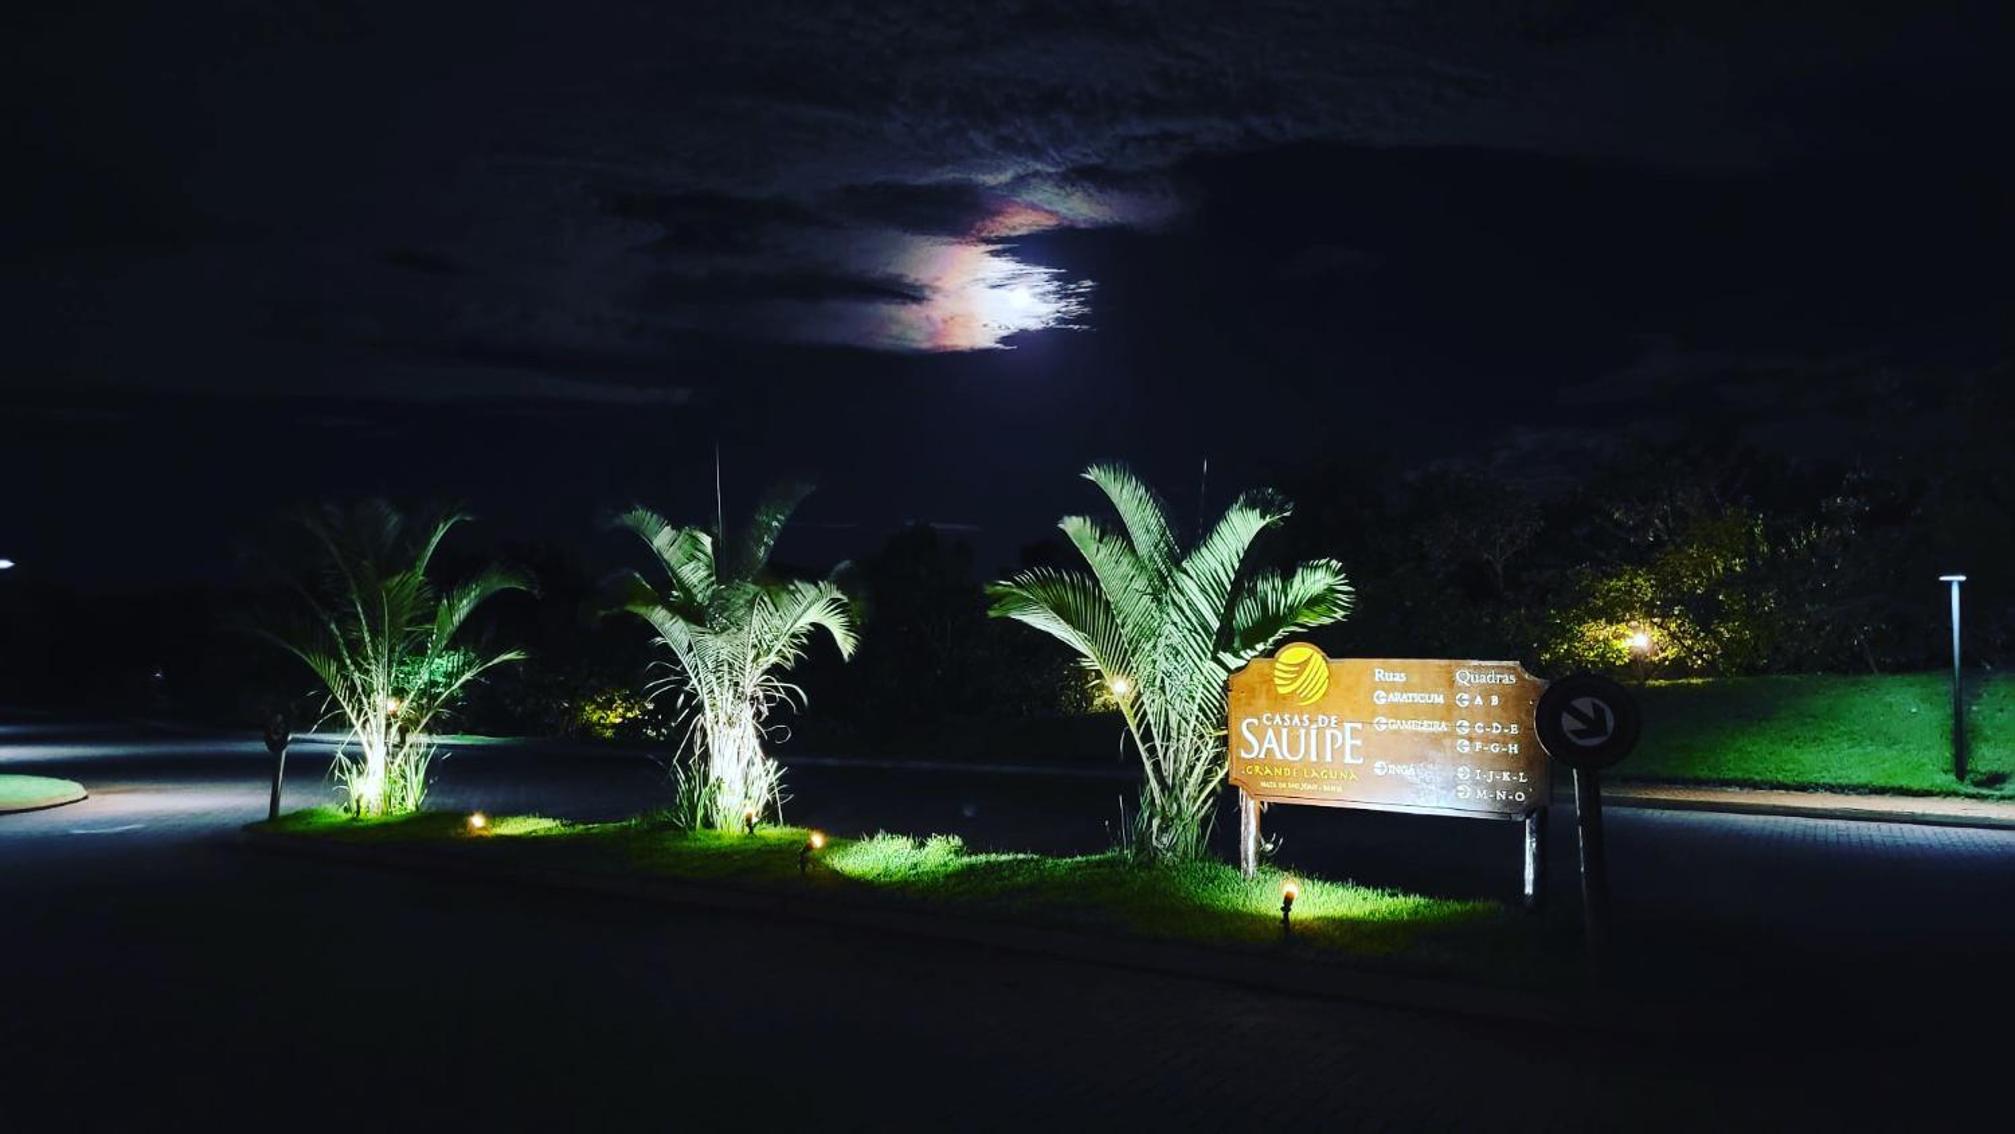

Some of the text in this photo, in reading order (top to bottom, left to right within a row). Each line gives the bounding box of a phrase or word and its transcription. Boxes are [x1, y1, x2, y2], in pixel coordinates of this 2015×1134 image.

[1374, 668, 1407, 683] Ruas
[1455, 668, 1516, 687] Quadras
[1387, 691, 1445, 705] ARATICUM
[1262, 713, 1339, 728] CASAS DE
[1240, 718, 1365, 765] SAUÍPE
[1245, 764, 1359, 782] GRANDE LAGUNA
